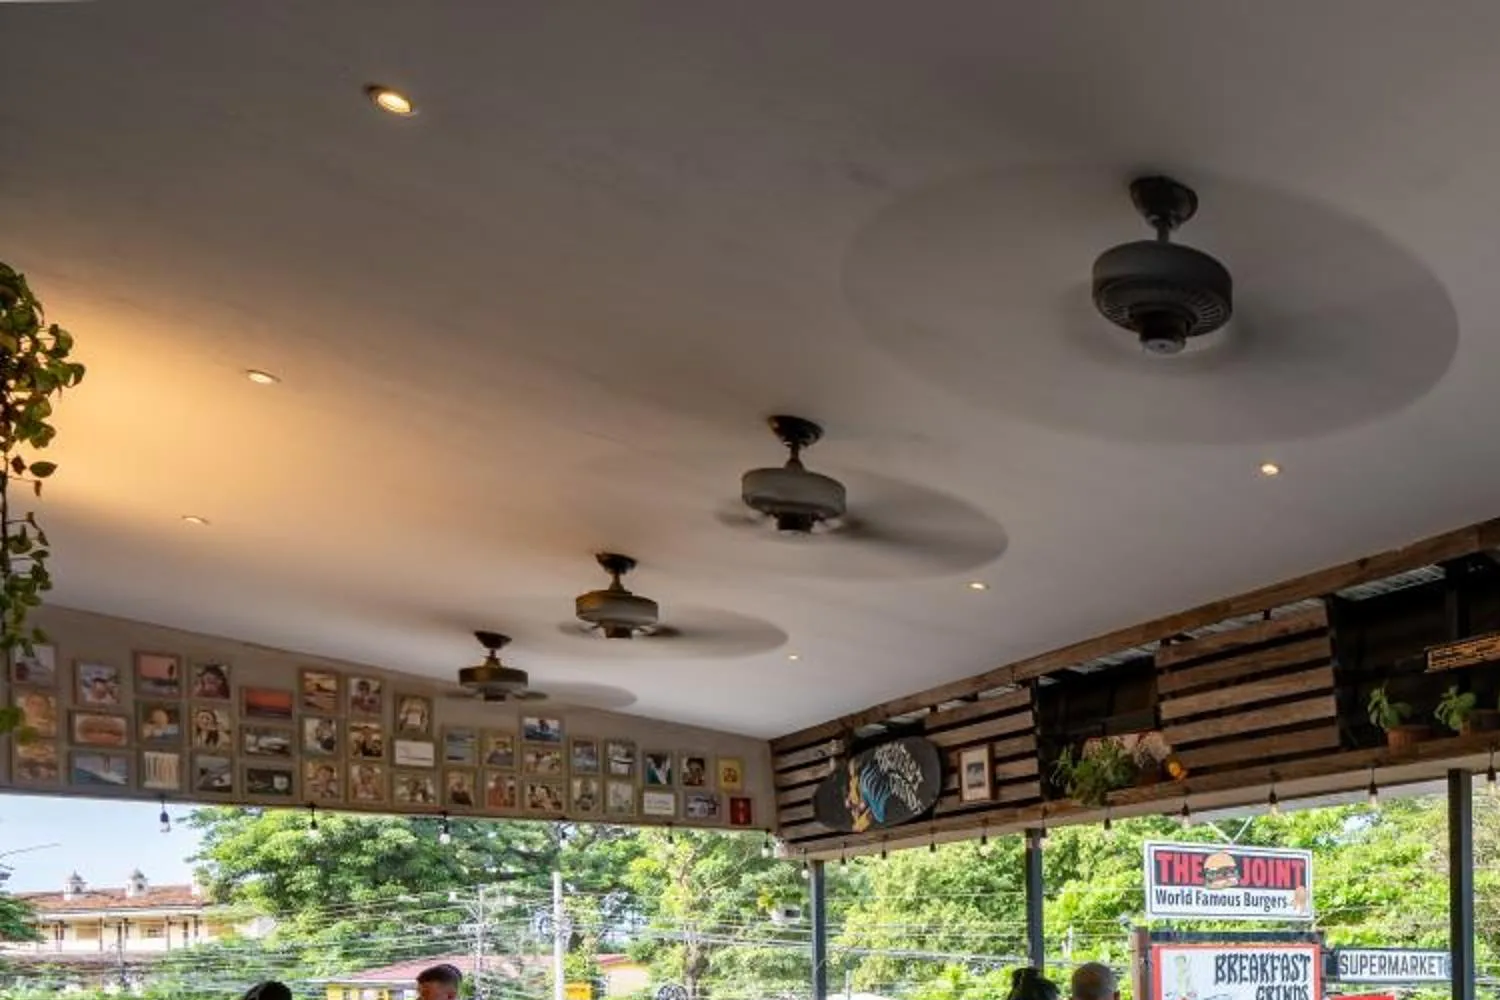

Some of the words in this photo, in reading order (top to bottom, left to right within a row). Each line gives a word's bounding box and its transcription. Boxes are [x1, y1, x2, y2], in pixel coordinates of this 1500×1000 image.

[1155, 851, 1205, 886] THE
[1240, 857, 1305, 889] JOINT
[1155, 888, 1193, 905] World
[1195, 890, 1241, 907] Famous
[1243, 892, 1288, 913] Burgers
[1214, 953, 1311, 986] BREAKFAST
[1340, 954, 1444, 977] SUPERMARKET
